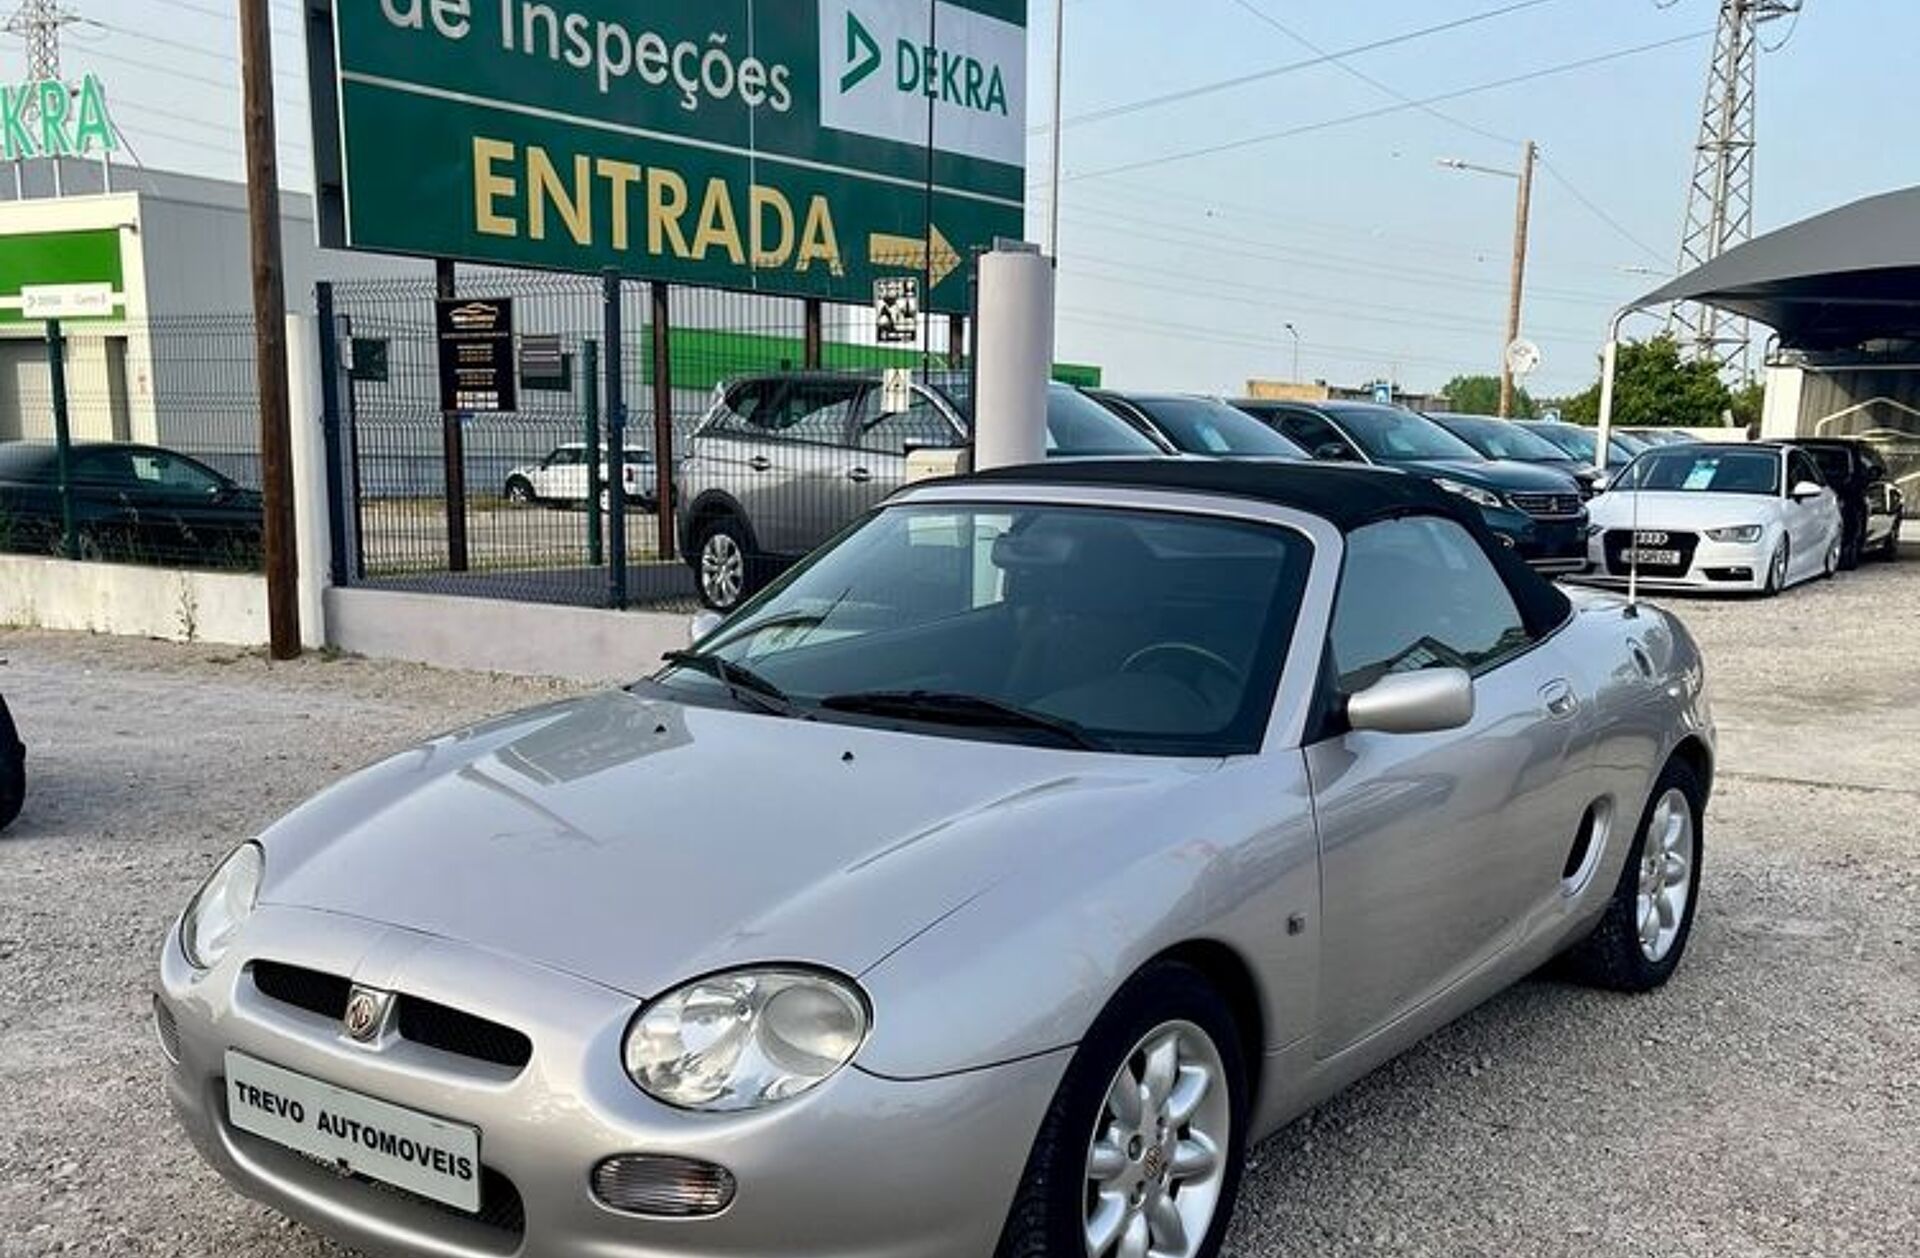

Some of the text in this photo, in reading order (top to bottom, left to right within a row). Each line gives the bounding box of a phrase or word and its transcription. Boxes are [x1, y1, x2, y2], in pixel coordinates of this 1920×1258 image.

[898, 38, 1007, 116] DEKRA
[473, 137, 844, 275] ENTRADA
[235, 1080, 473, 1181] TREVO AUTOMOVEIS
